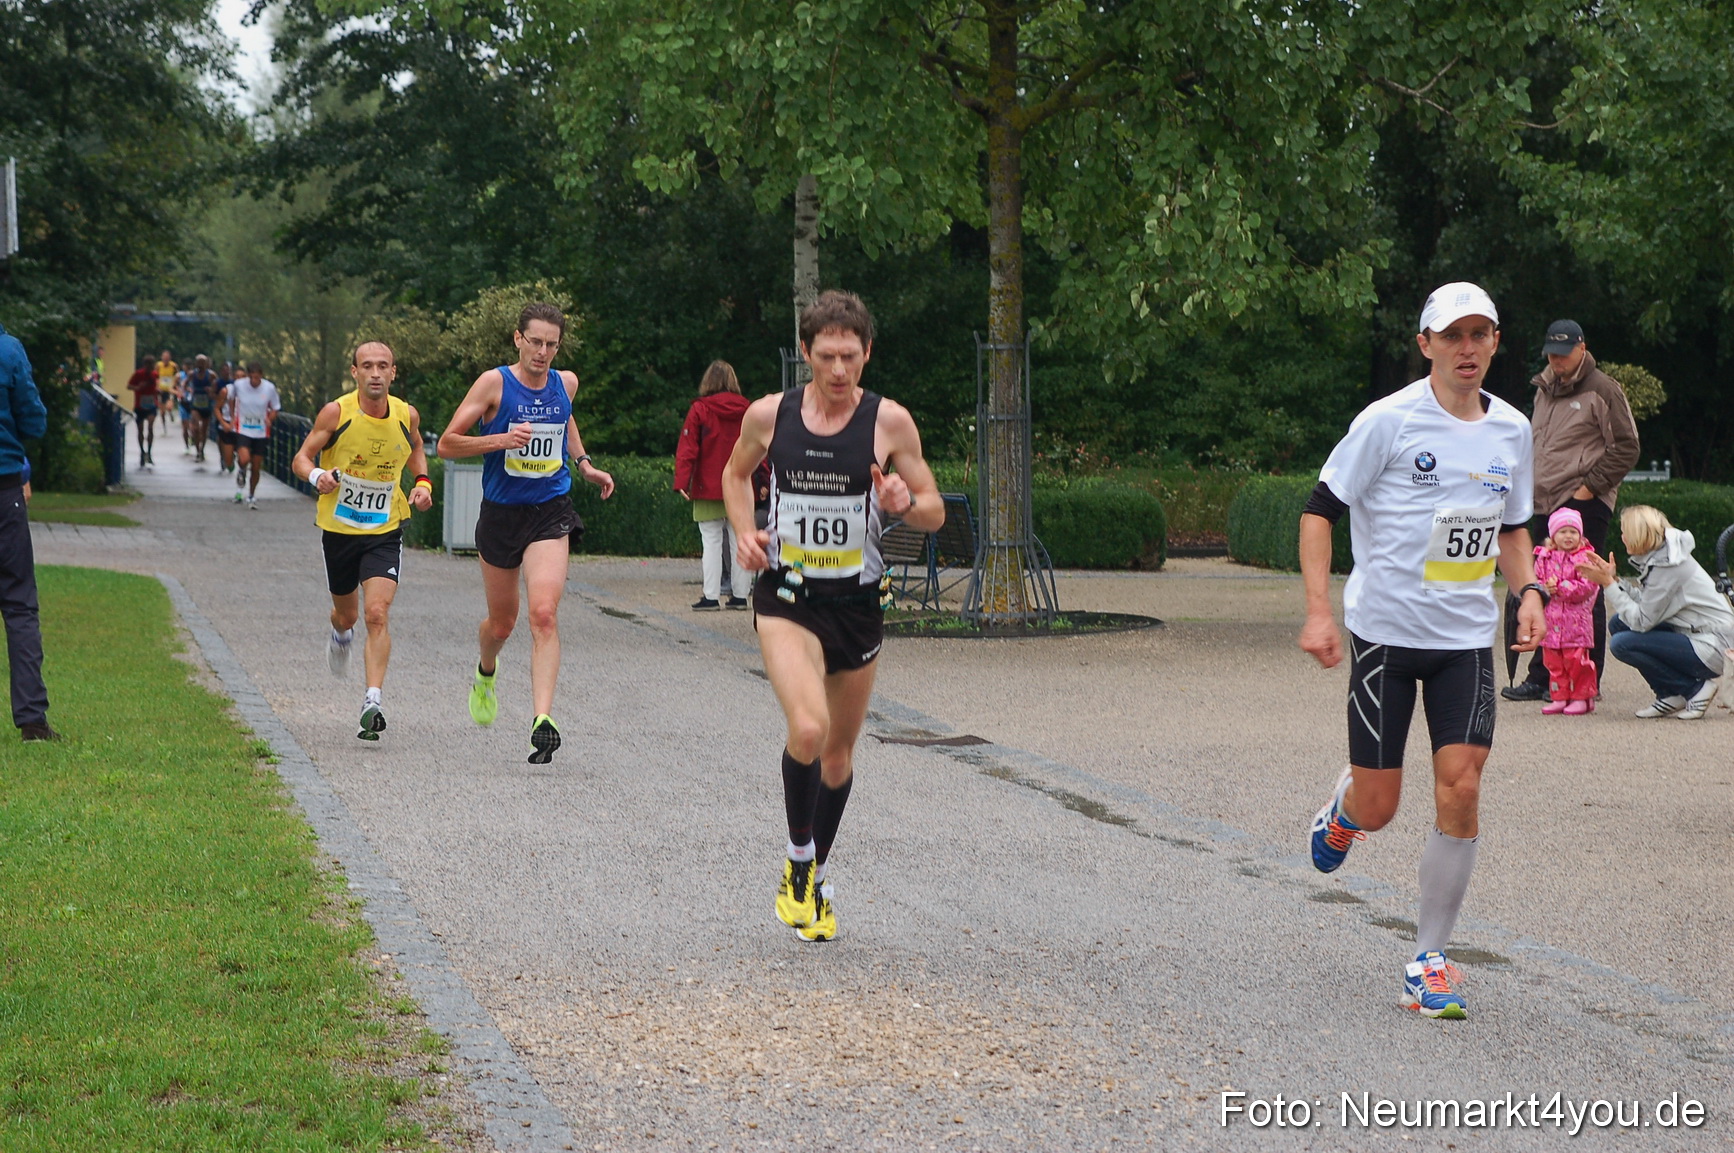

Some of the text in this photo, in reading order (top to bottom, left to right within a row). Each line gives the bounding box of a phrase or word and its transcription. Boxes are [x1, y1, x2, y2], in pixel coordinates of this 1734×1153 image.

[517, 404, 560, 415] ELOTEC
[521, 462, 546, 471] Martin
[806, 470, 850, 483] Marathon
[1412, 473, 1440, 482] PARTL
[791, 479, 846, 493] Regensburg
[1412, 480, 1440, 488] Neumarkt
[343, 488, 387, 510] 2410
[808, 505, 850, 514] Neumarkt
[349, 511, 373, 523] Jürgen
[1435, 516, 1463, 524] PARTL
[794, 517, 848, 546] 169
[1446, 526, 1495, 558] 587
[801, 552, 839, 567] Jürgen
